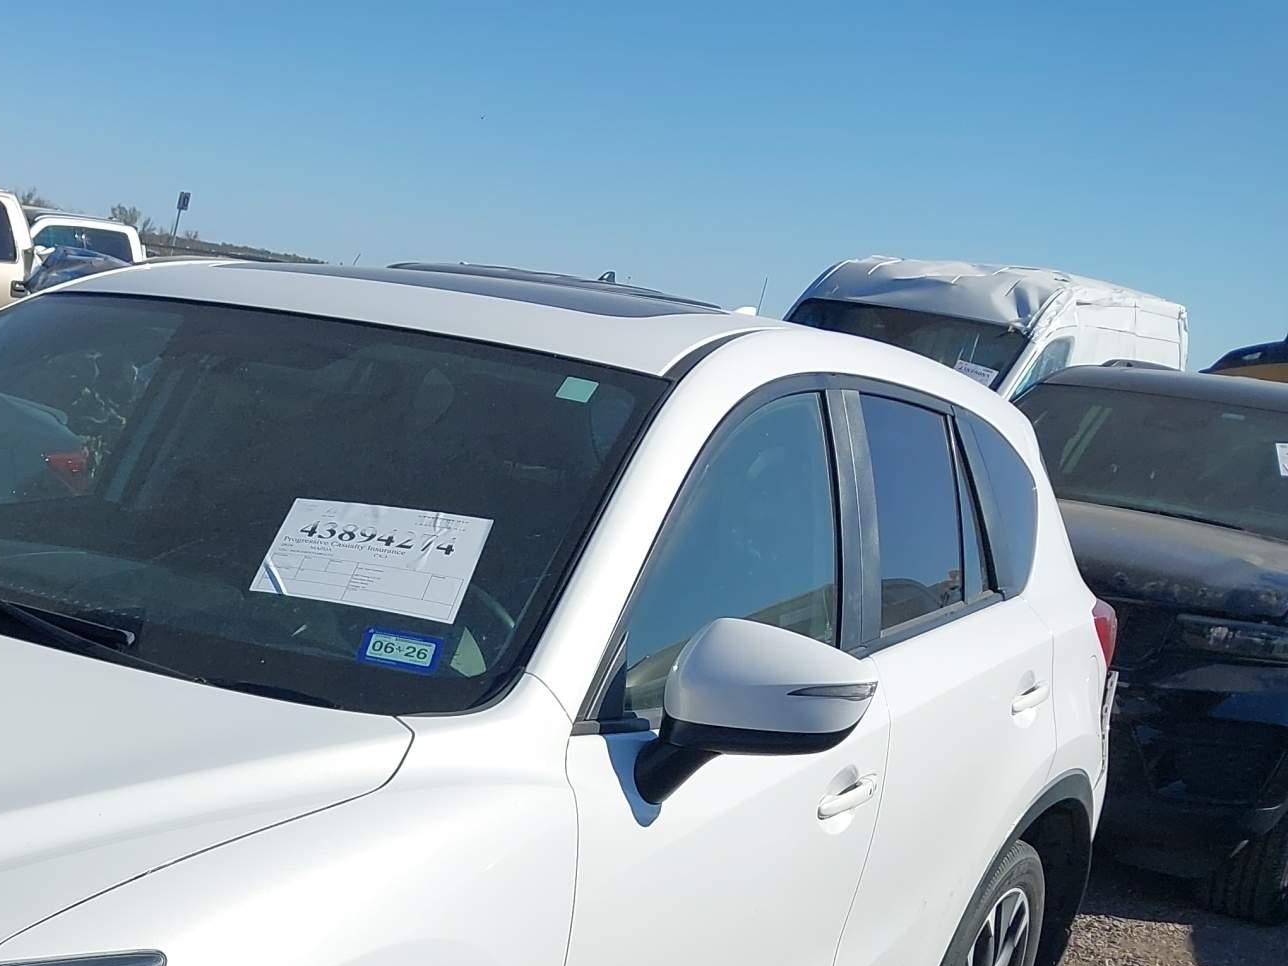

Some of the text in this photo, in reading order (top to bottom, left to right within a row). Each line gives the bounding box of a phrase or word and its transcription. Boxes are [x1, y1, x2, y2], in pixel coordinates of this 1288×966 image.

[284, 536, 329, 546] Progressive
[331, 541, 365, 551] Casualty
[367, 546, 407, 556] Insurance
[299, 521, 455, 556] 43894274
